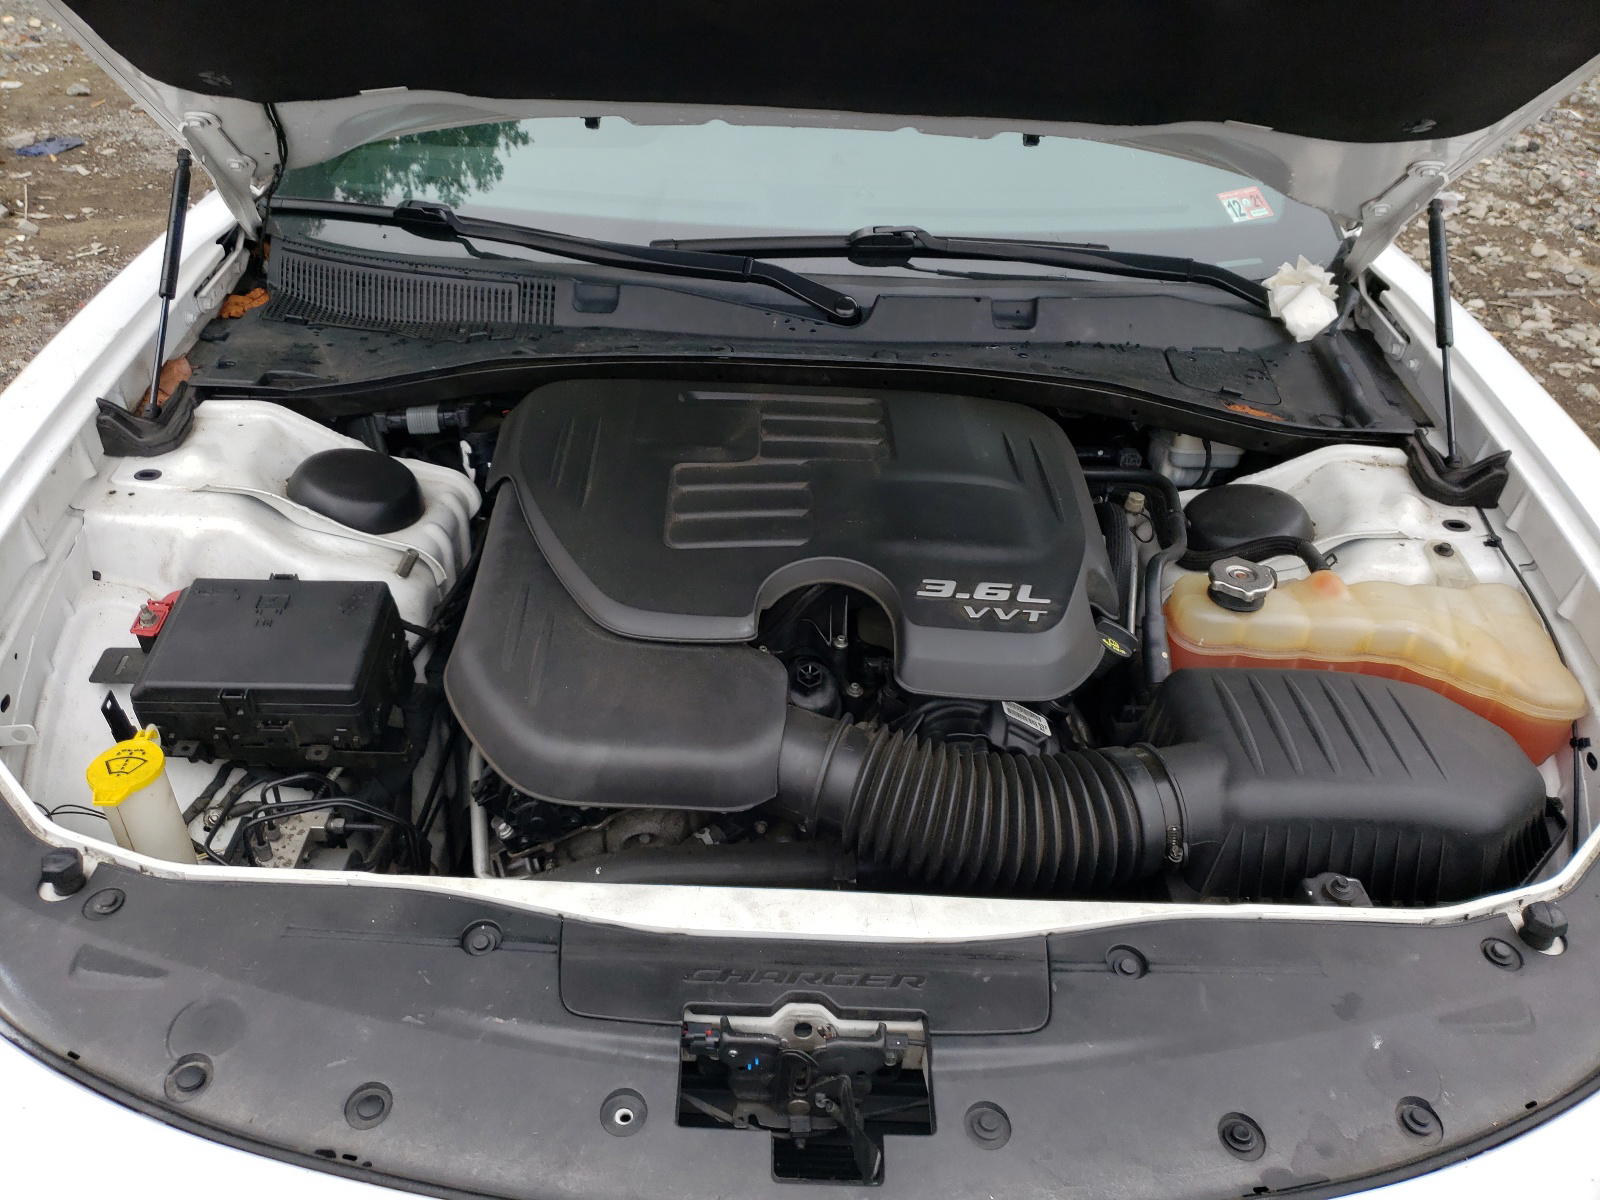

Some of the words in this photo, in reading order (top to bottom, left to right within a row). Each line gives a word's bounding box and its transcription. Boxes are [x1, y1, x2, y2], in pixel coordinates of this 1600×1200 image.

[1227, 199, 1247, 218] 12
[916, 578, 1052, 604] 3.6L
[963, 605, 1048, 622] VVT
[682, 968, 928, 991] CHARGER
